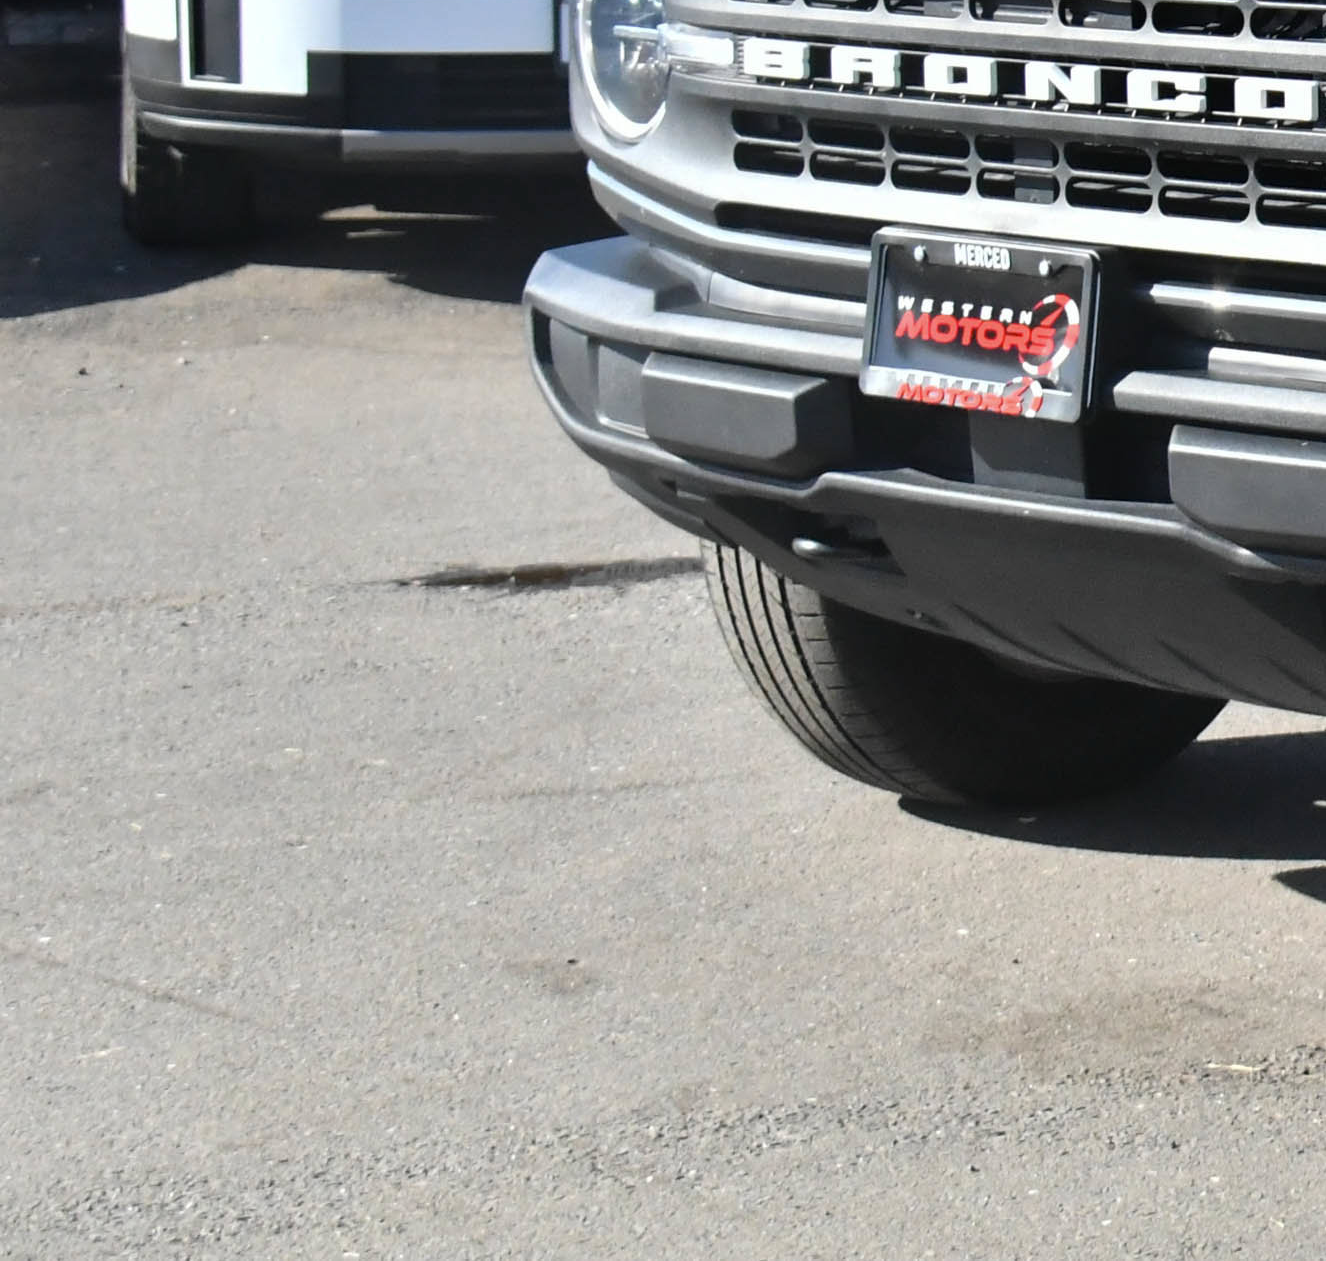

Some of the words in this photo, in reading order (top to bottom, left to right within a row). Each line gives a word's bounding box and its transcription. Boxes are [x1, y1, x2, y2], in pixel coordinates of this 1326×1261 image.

[743, 37, 1319, 123] BRONCO
[953, 242, 1012, 271] MERCED
[897, 295, 1033, 325] WESTERN
[895, 310, 1057, 356] MOTORS
[896, 382, 1024, 417] MOTORS
